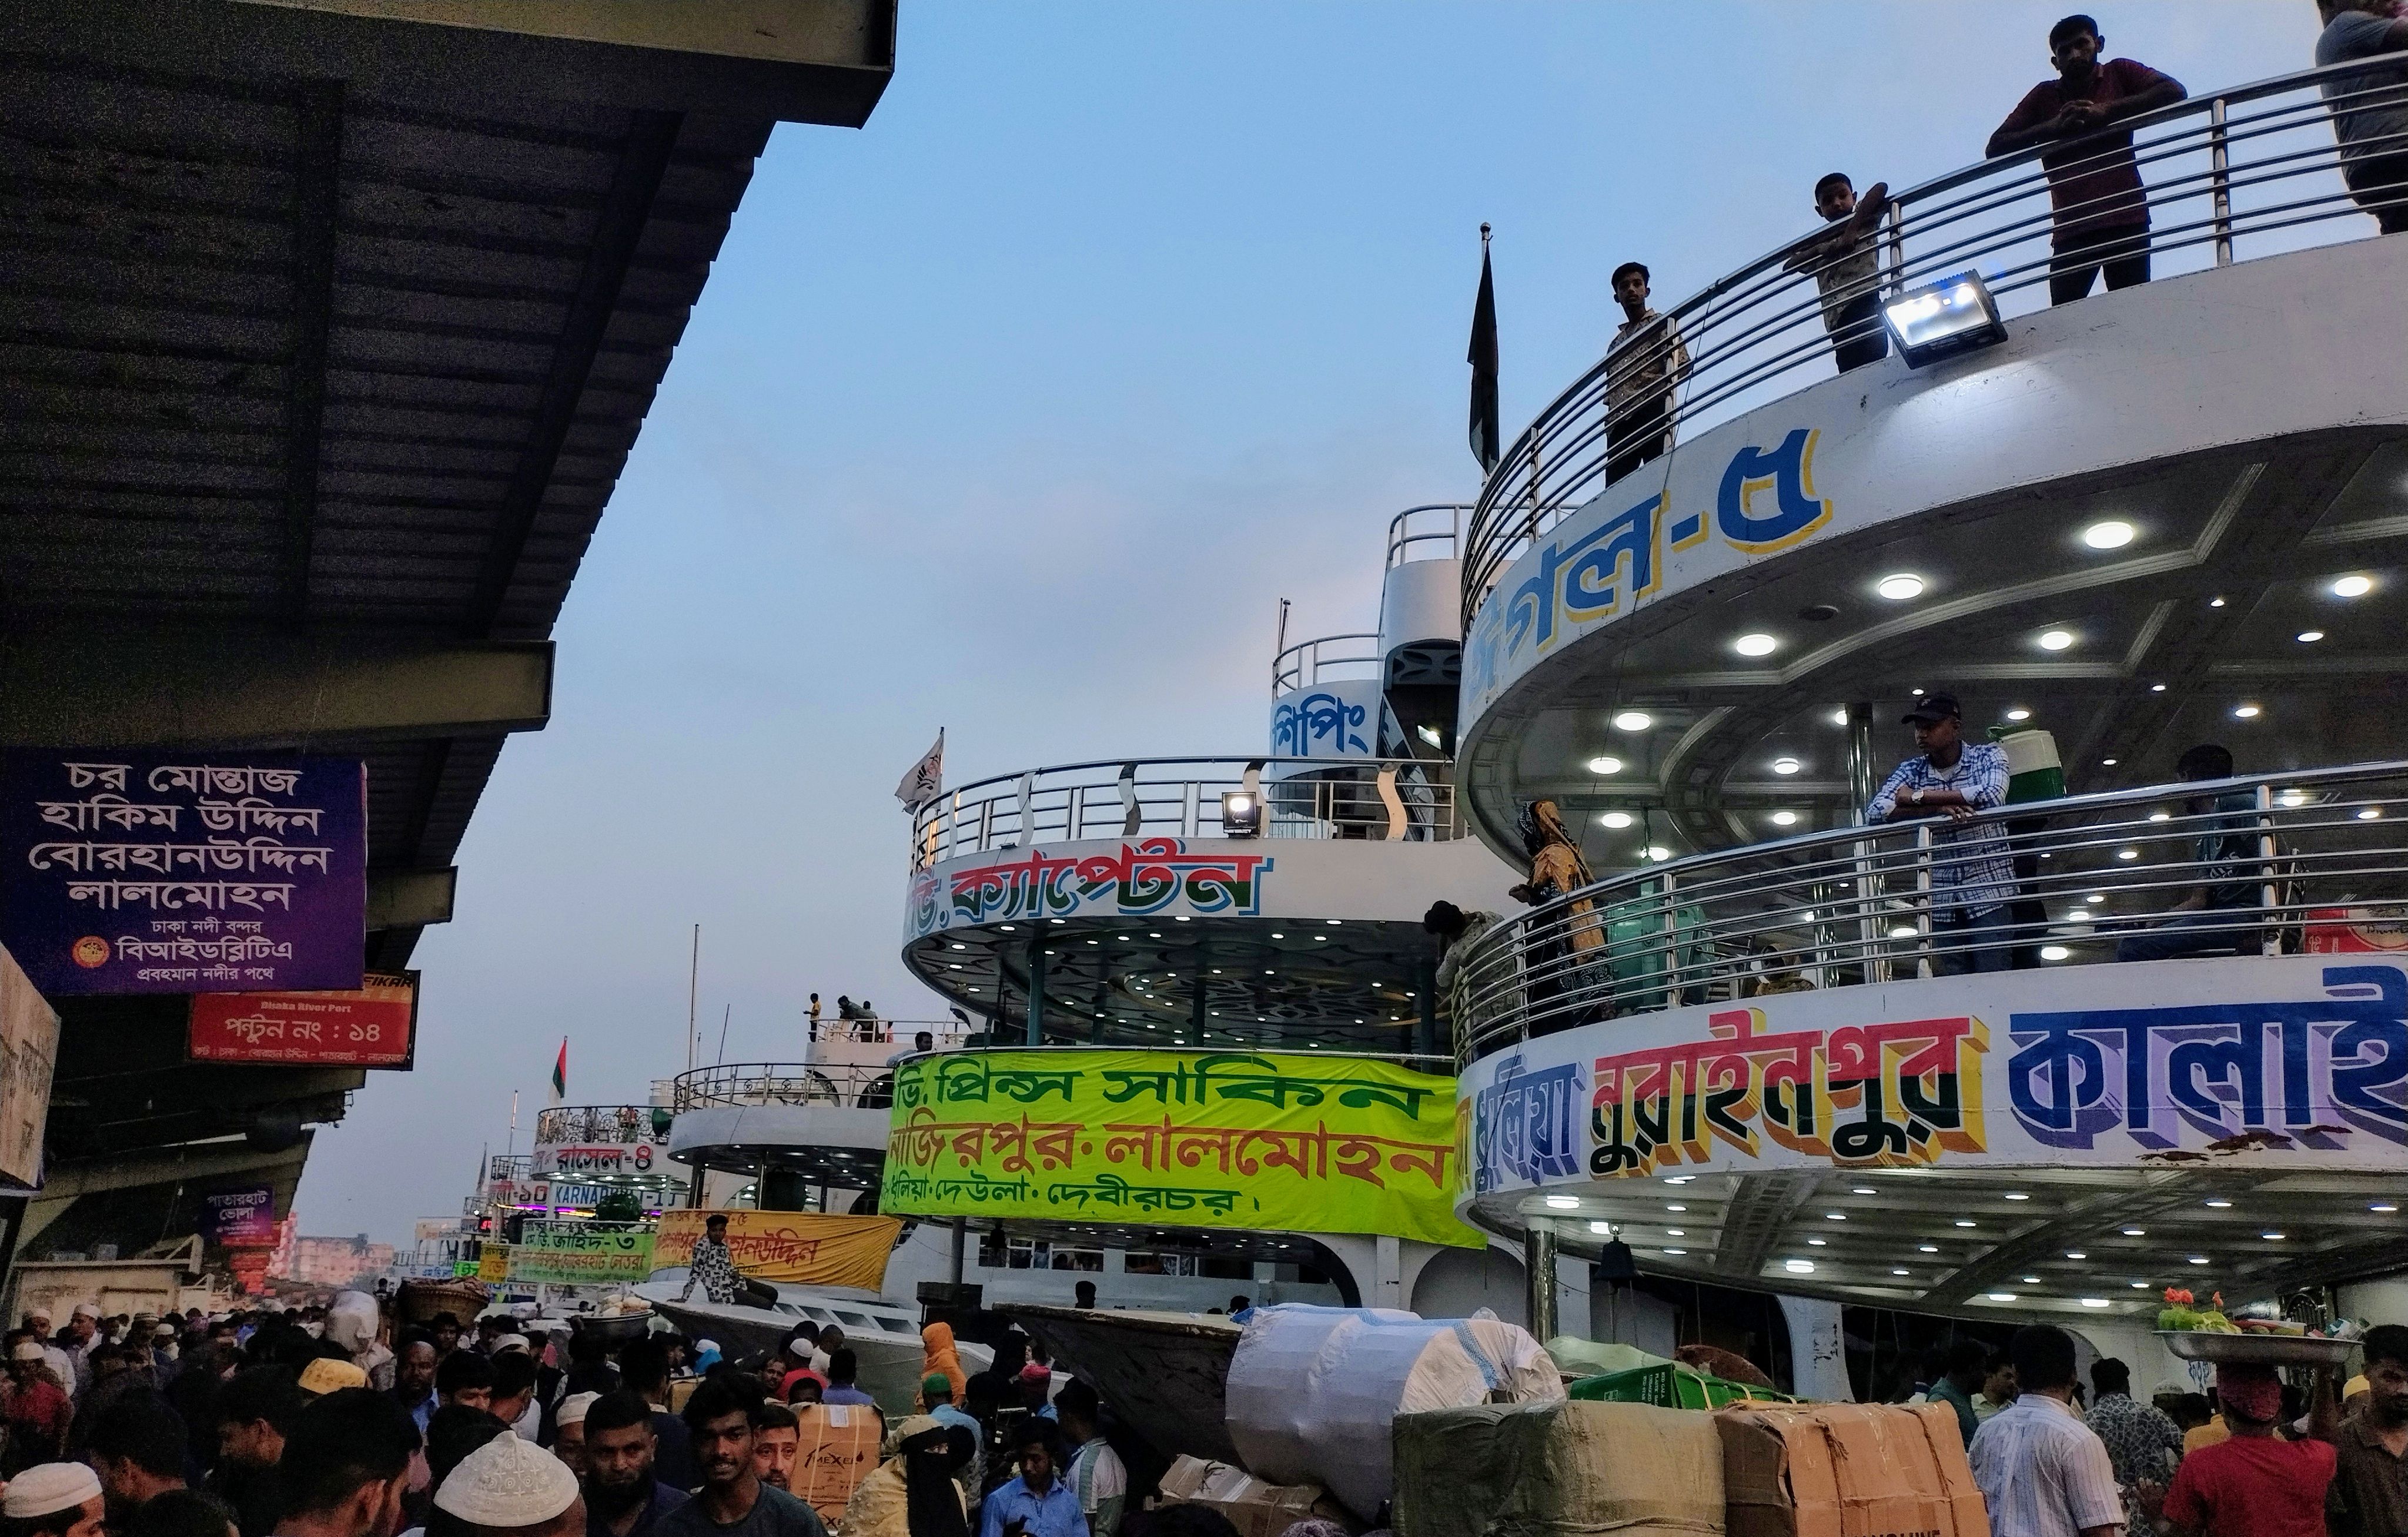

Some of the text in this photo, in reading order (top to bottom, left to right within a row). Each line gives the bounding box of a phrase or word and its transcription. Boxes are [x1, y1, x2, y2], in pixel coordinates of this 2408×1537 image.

[62, 762, 132, 792] চর
[36, 796, 325, 836] হাকিম উদ্দিন
[28, 835, 335, 875] বোরহানউদ্দিন
[66, 878, 297, 912] লালমোহন
[151, 916, 263, 934] ঢাকা নদী বন্দর
[137, 965, 274, 982] প্রবহমান নদীর পথে
[297, 1002, 326, 1012] River
[328, 1003, 351, 1013] Port
[292, 1020, 322, 1043] নং
[349, 1023, 381, 1042] ১৪
[1103, 1054, 1434, 1121] সাকিন
[1589, 1007, 1989, 1178] নুরাইনপুর
[1103, 1112, 1454, 1189] লালমোহন
